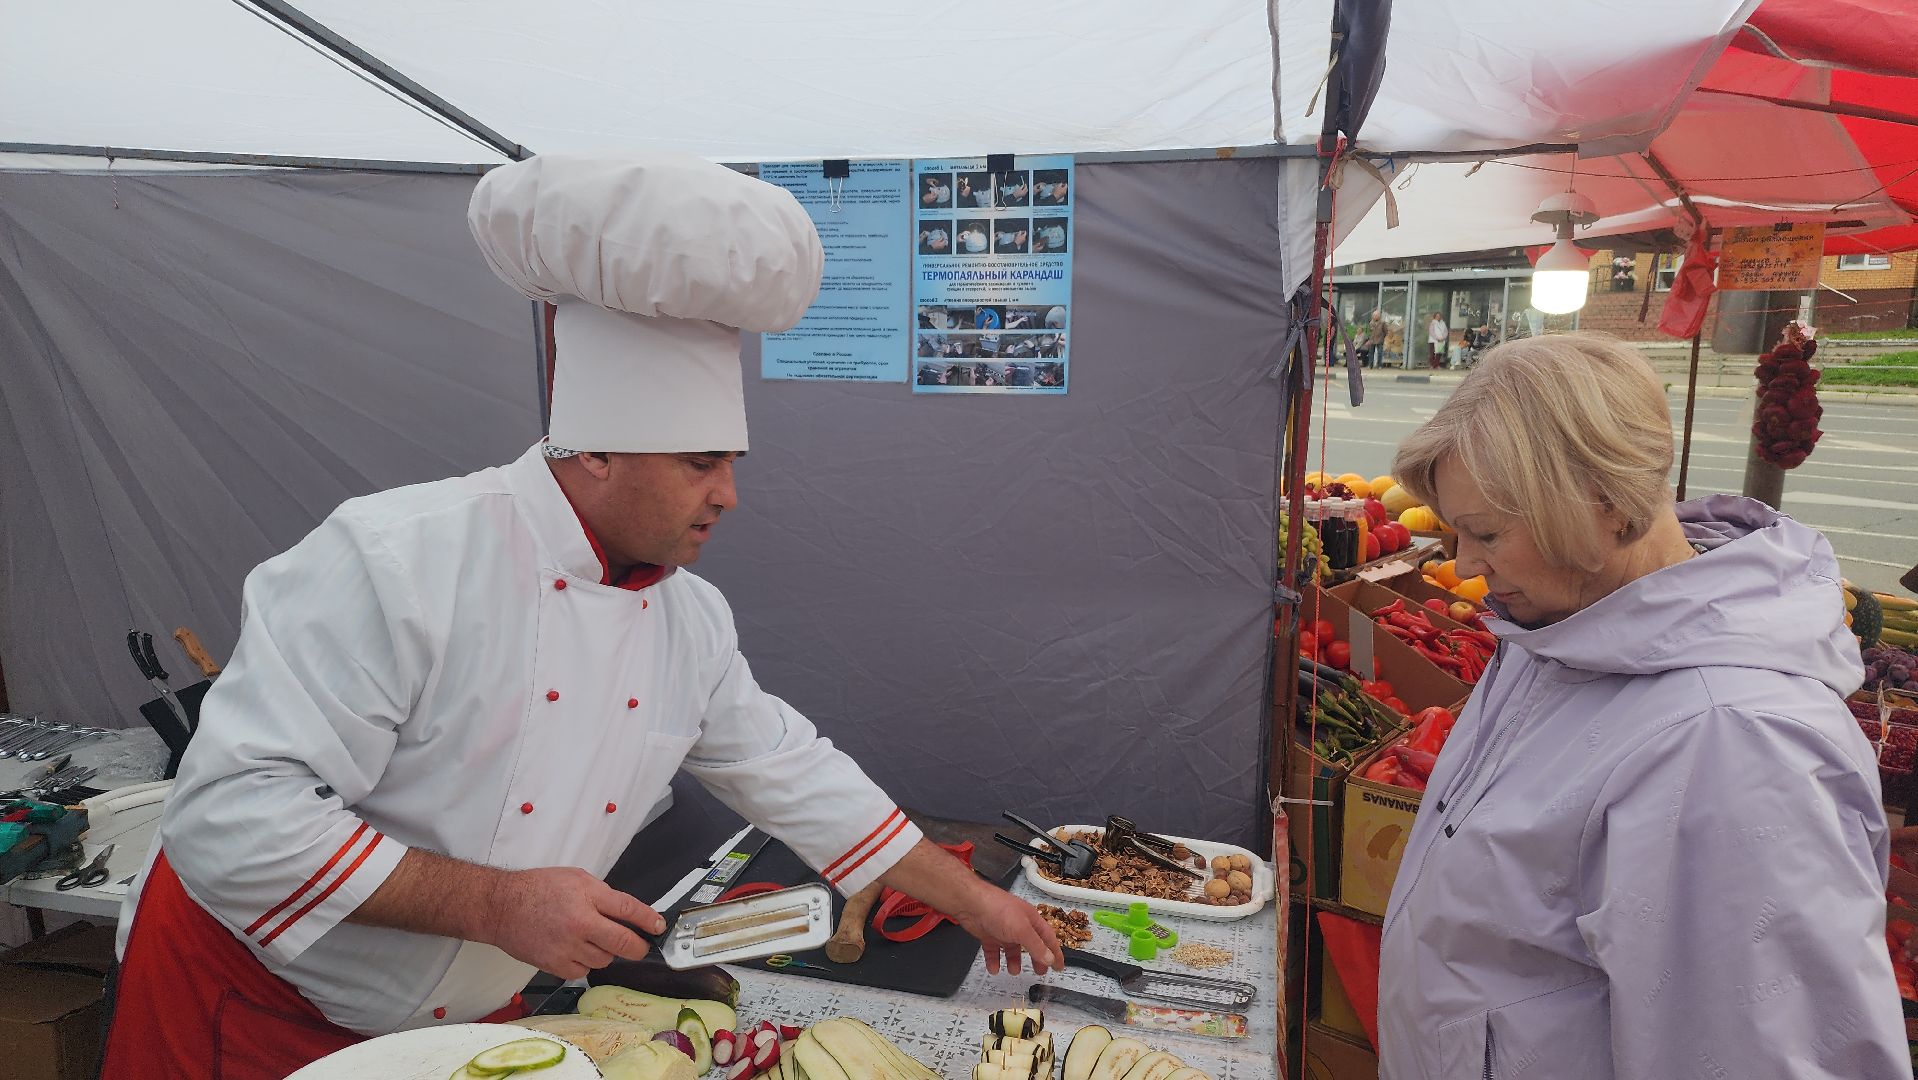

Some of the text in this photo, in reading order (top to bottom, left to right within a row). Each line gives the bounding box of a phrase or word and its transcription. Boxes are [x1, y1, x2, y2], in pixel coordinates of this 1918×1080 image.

[922, 268, 1063, 281] ТЕРМОПАЯЛЬНЫЙ КАРАНДАШ
[1363, 792, 1420, 814] BANANAS
